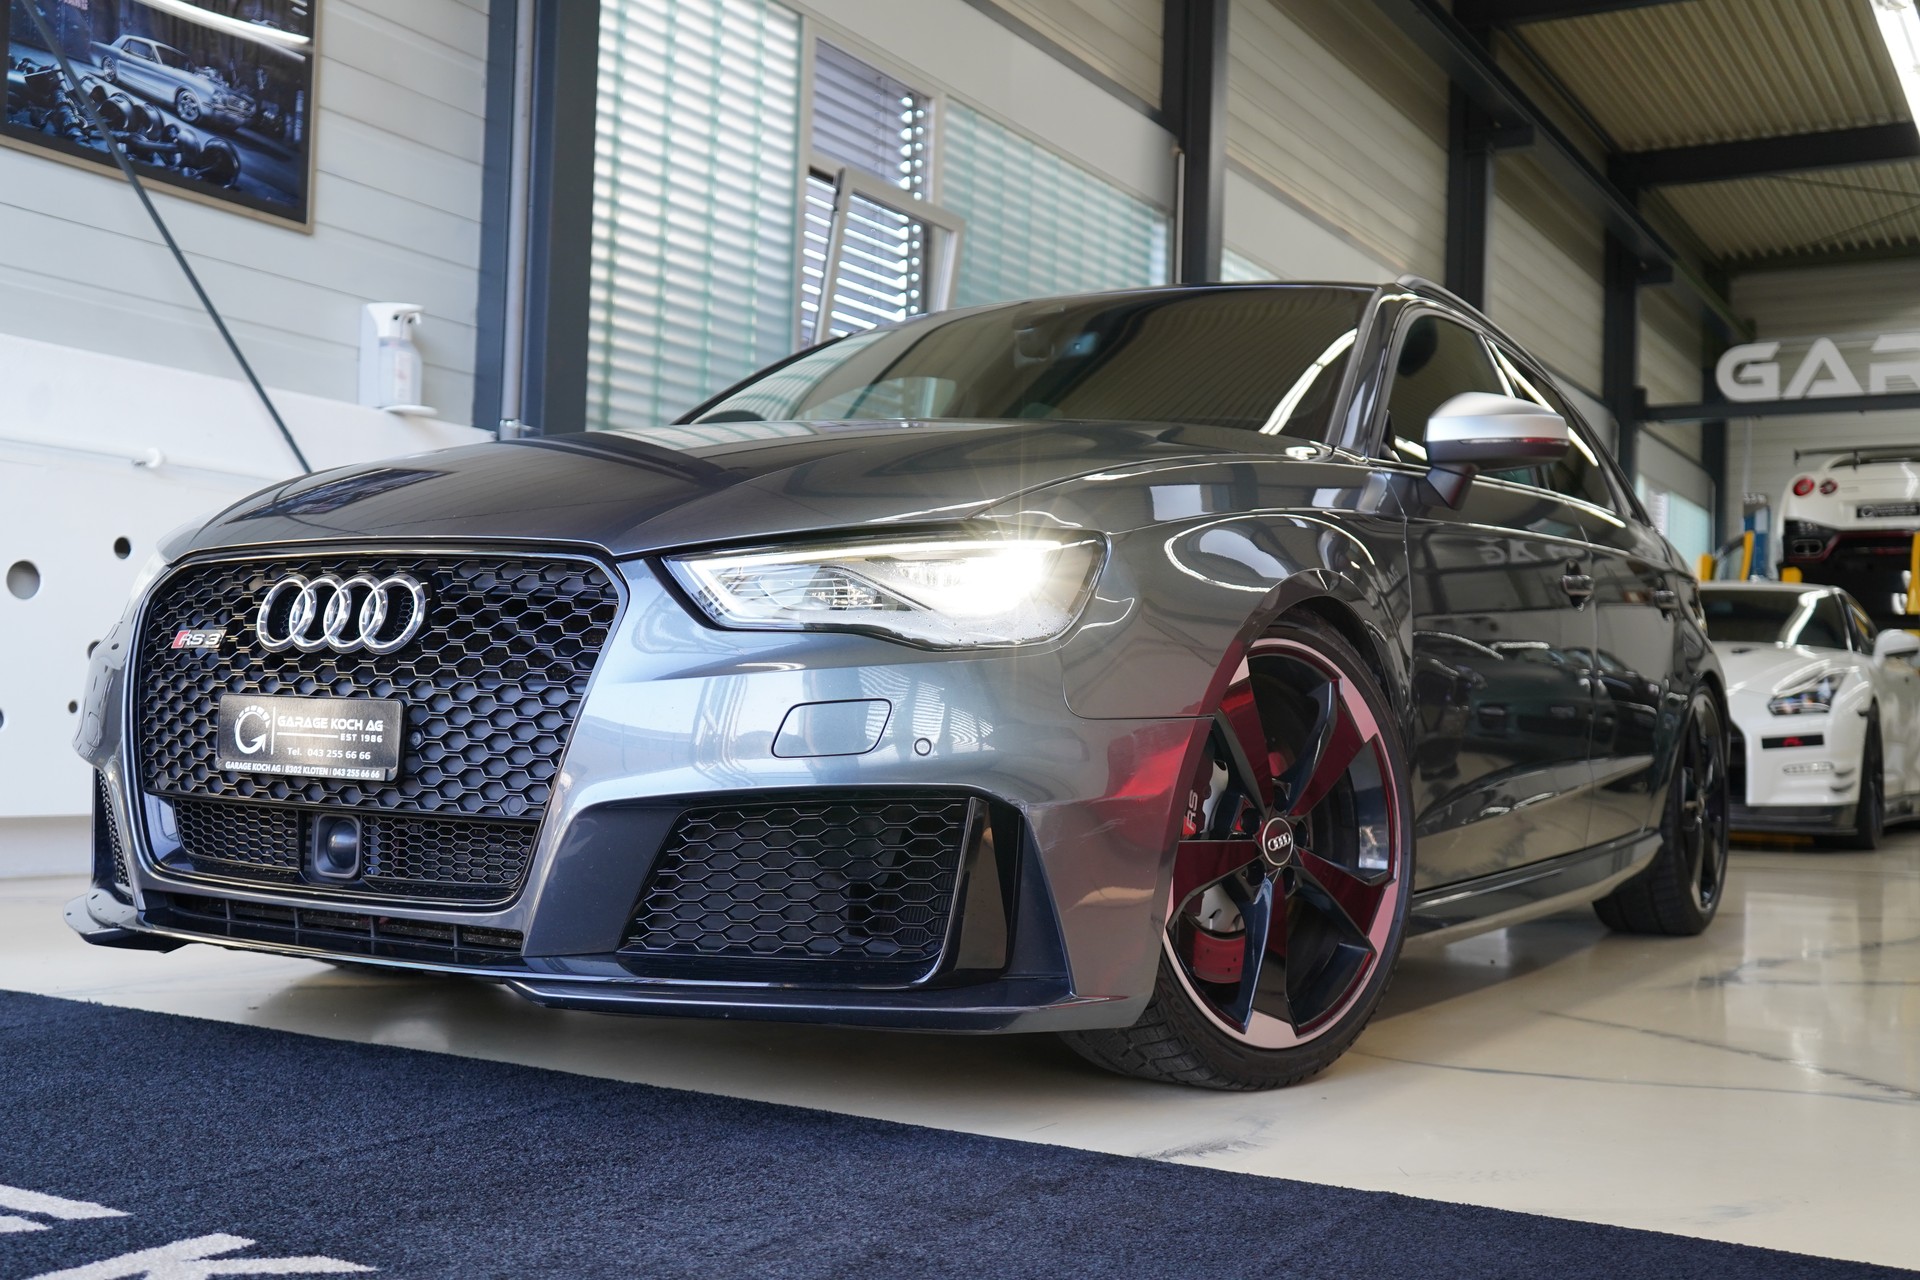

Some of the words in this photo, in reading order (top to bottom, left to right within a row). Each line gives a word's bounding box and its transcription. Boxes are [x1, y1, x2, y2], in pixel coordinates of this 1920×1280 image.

[277, 715, 329, 729] GARAGE
[330, 718, 363, 731] KOCH
[365, 719, 384, 732] AG
[340, 733, 357, 741] EST
[361, 734, 383, 743] 1986
[287, 747, 302, 756] Tel.
[307, 749, 324, 757] 043
[326, 750, 343, 758] 255
[345, 751, 357, 759] 66
[359, 752, 371, 760] 66
[225, 761, 252, 771] GARAGE
[252, 763, 271, 772] KOCH
[271, 764, 281, 773] AG
[285, 765, 302, 774] 8302
[303, 766, 328, 776] KLOTEN
[333, 768, 345, 776] 043
[346, 769, 360, 777] 255
[361, 769, 370, 778] 66
[371, 770, 380, 779] 66
[1186, 789, 1198, 831] RS
